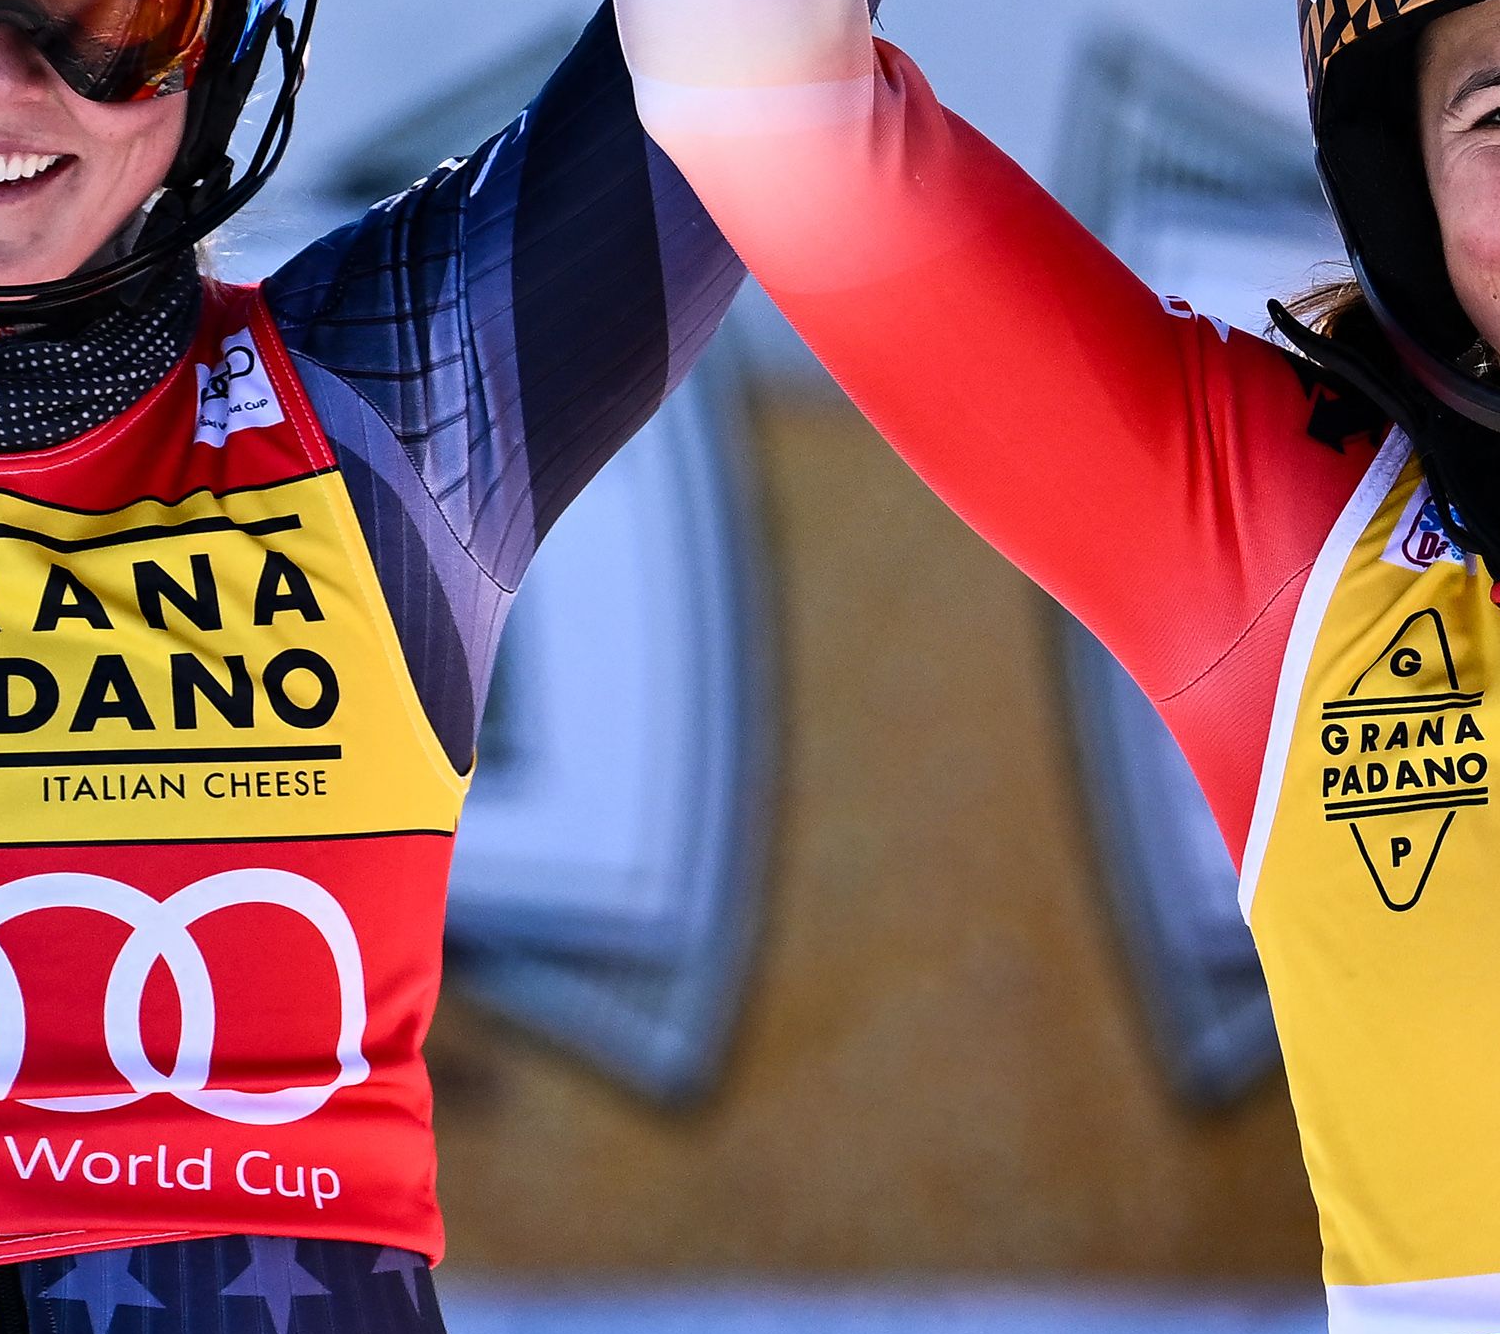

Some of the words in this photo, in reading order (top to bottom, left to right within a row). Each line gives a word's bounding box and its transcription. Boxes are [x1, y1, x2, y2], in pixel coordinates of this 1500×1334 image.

[1390, 648, 1421, 678] G
[1321, 713, 1483, 755] GRANA
[42, 772, 186, 803] ITALIAN
[203, 769, 328, 799] CHEESE
[1323, 752, 1488, 798] PADANO
[1391, 837, 1413, 869] P
[3, 1132, 214, 1194] World
[236, 1150, 342, 1212] Cup
